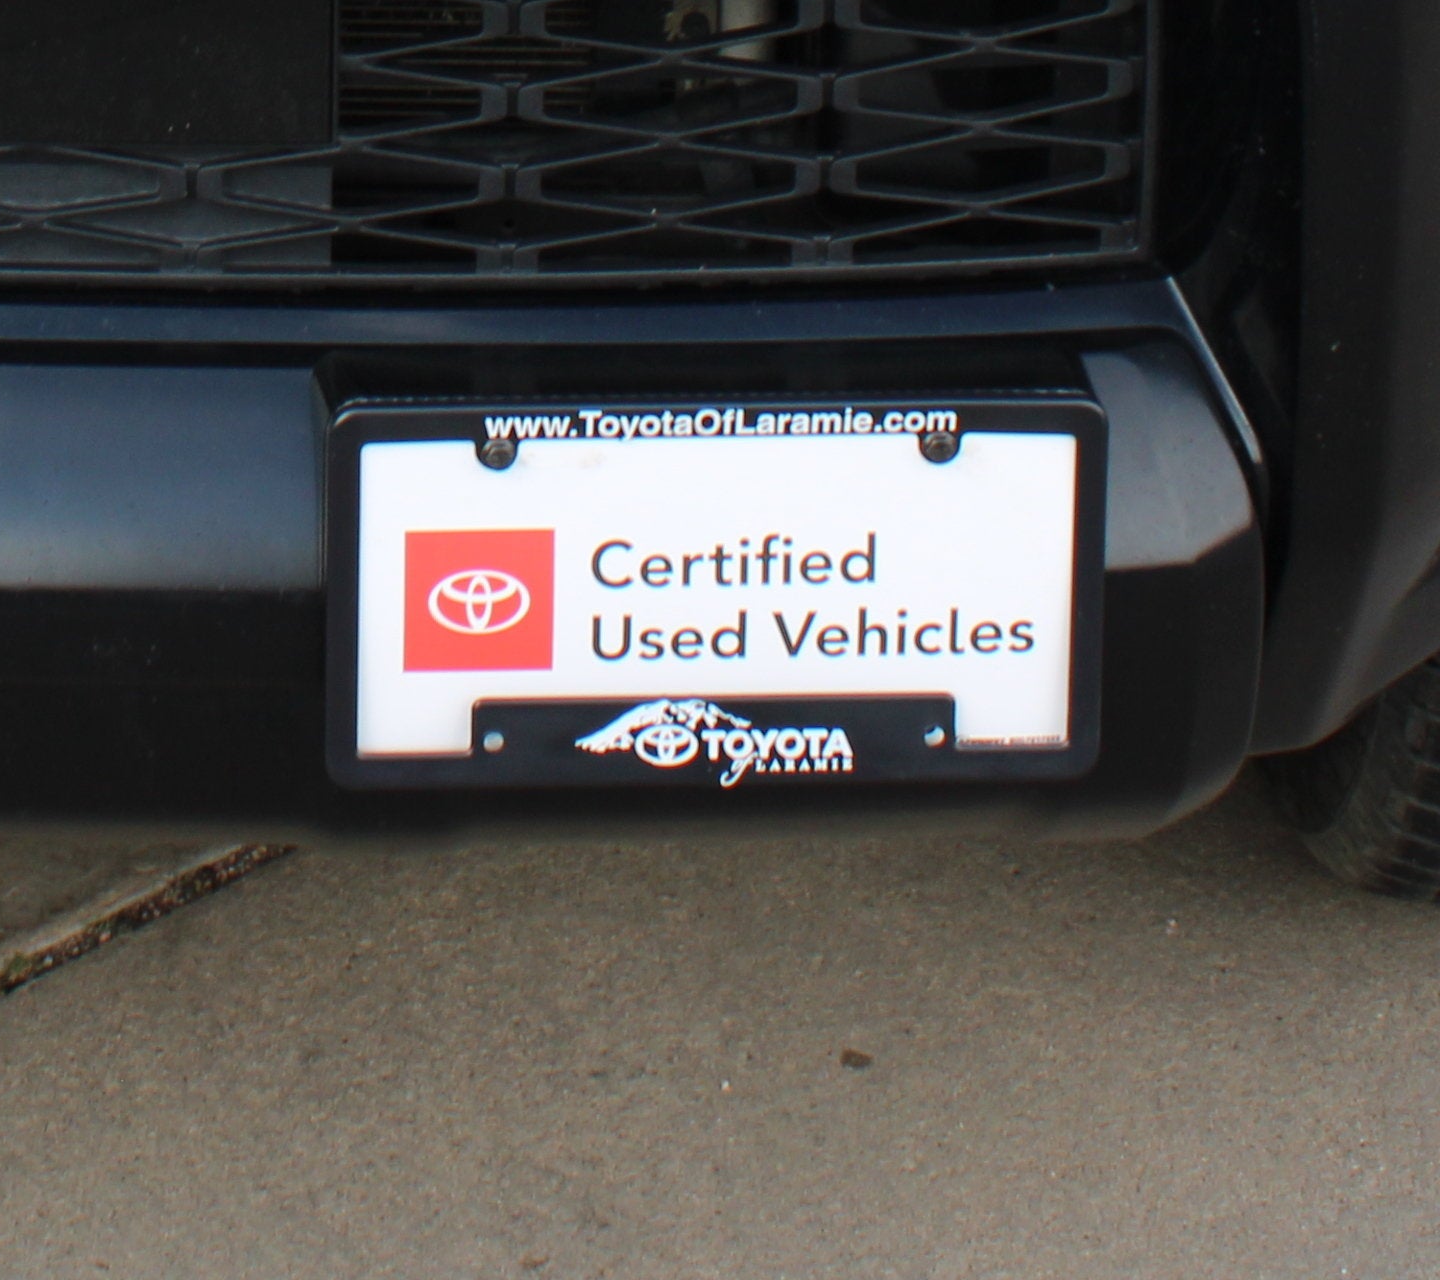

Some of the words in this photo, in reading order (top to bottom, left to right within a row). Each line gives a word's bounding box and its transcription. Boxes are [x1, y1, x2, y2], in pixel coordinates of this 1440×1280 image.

[485, 409, 957, 440] www.ToyotaOfLaramie.com
[591, 532, 877, 587] Certified
[591, 610, 748, 660] Used
[773, 608, 1035, 657] Vehicles
[702, 728, 855, 761] TOYOTA
